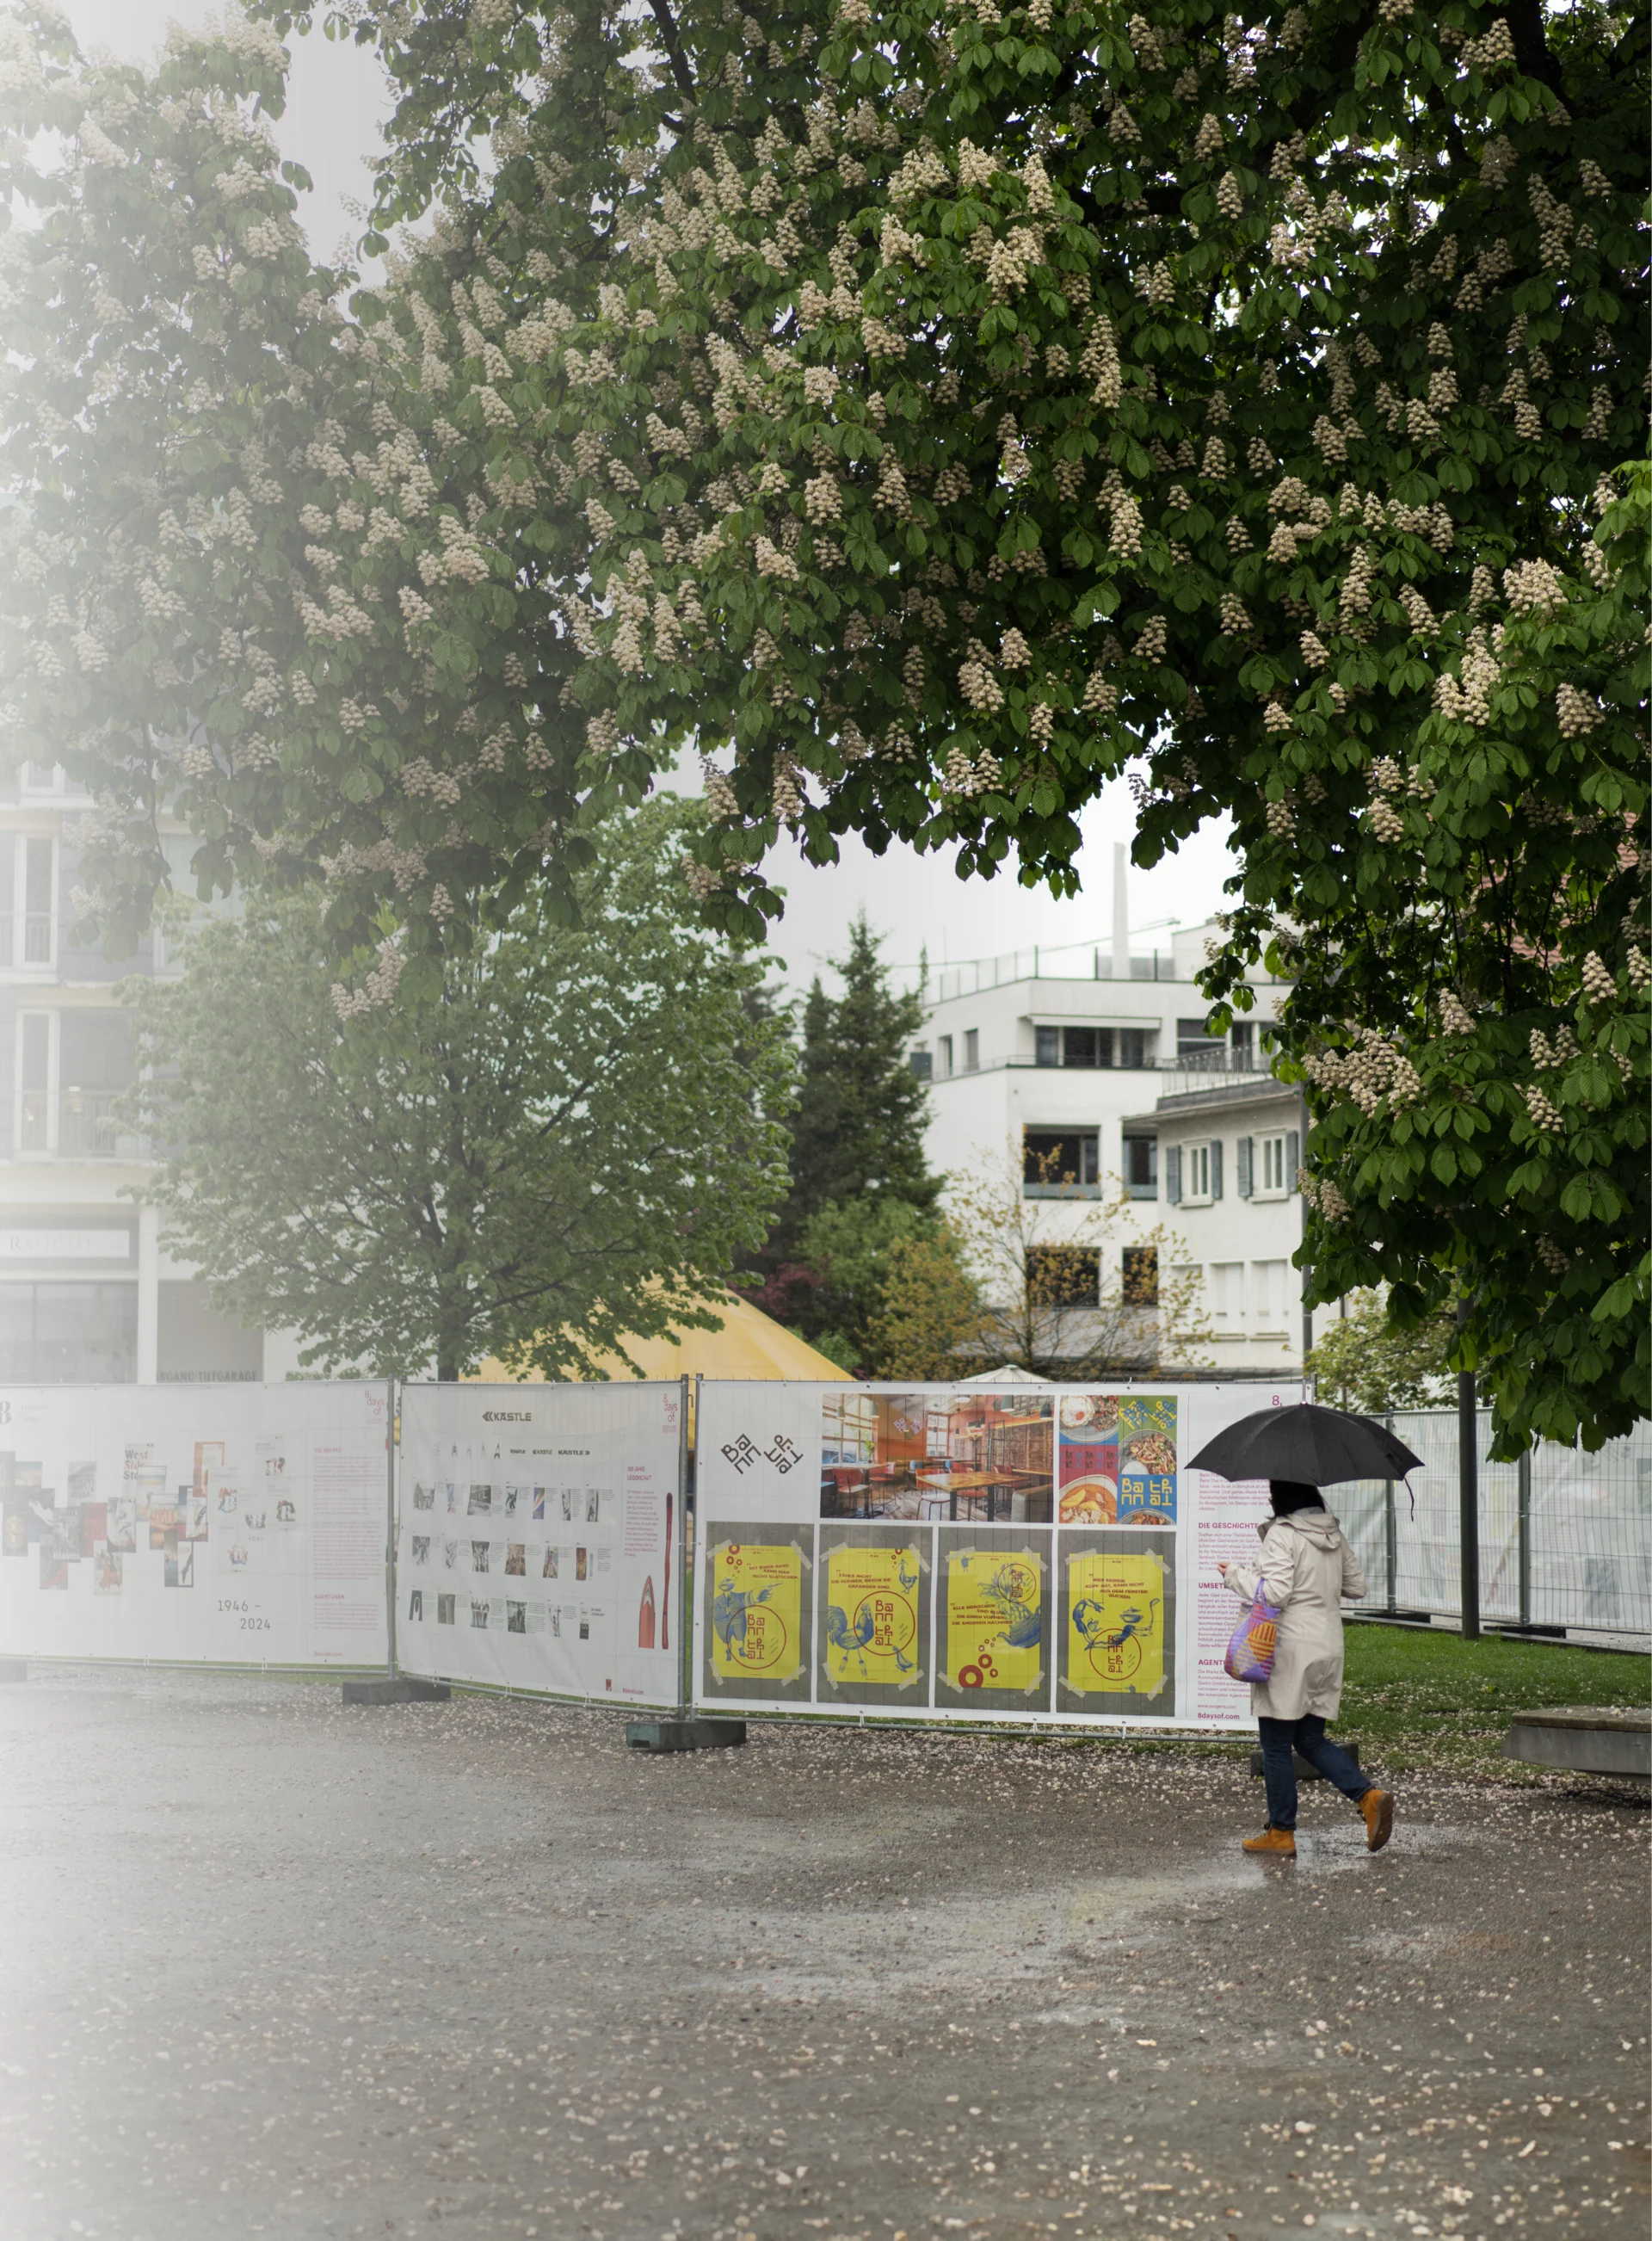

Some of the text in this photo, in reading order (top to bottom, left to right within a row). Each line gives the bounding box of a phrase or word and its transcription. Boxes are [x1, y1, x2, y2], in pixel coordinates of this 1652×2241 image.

[157, 1371, 193, 1381] BGANG
[367, 1396, 385, 1407] days
[1272, 1395, 1279, 1406] 8
[373, 1406, 382, 1416] of
[664, 1401, 678, 1414] days
[668, 1412, 675, 1422] of
[126, 1449, 148, 1459] West
[218, 1600, 248, 1611] 1946
[240, 1618, 271, 1630] 2024
